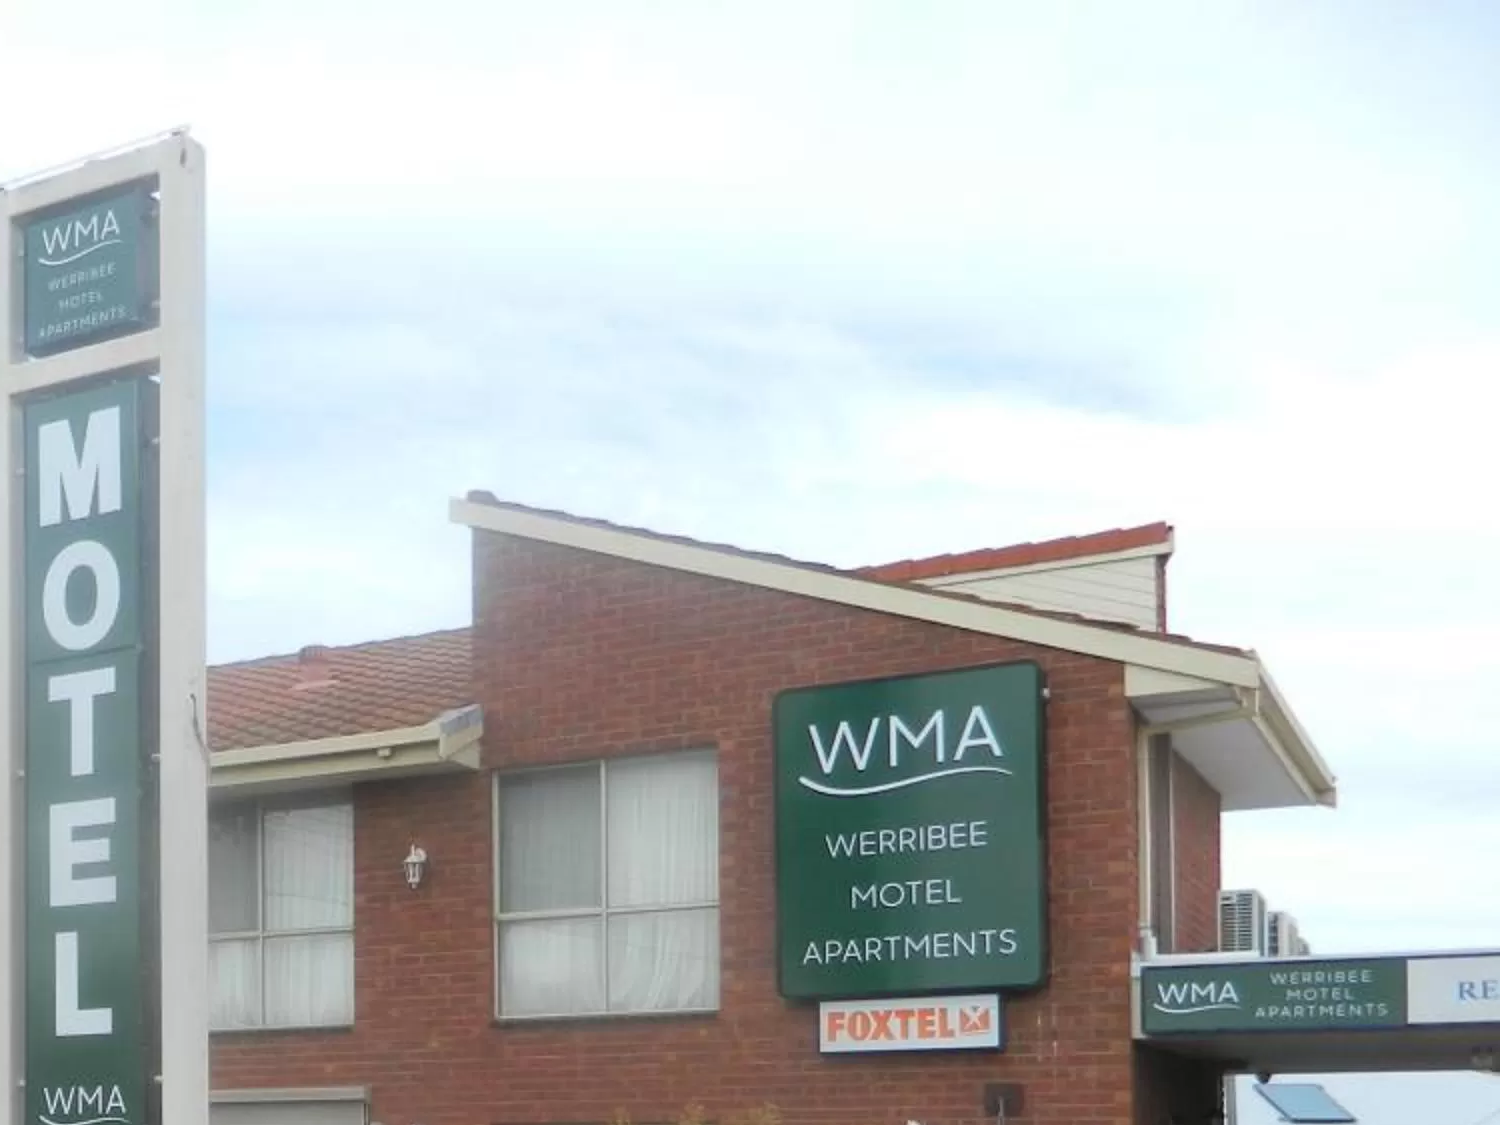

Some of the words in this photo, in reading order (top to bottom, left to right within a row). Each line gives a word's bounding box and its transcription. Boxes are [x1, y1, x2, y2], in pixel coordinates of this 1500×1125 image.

[42, 209, 119, 256] WMA
[38, 405, 121, 1037] MOTEL
[809, 705, 1003, 774] WMA
[825, 821, 988, 858] WERRIBEE
[851, 879, 962, 909] MOTEL
[803, 929, 1017, 965] APARTMENTS
[1158, 981, 1239, 1004] WMA
[1269, 969, 1373, 985] WERRIBEE
[1286, 986, 1354, 1001] MOTEL
[827, 1008, 954, 1042] FOXTEL
[1255, 1003, 1389, 1018] APARTMENTS
[43, 1085, 126, 1115] WMA
